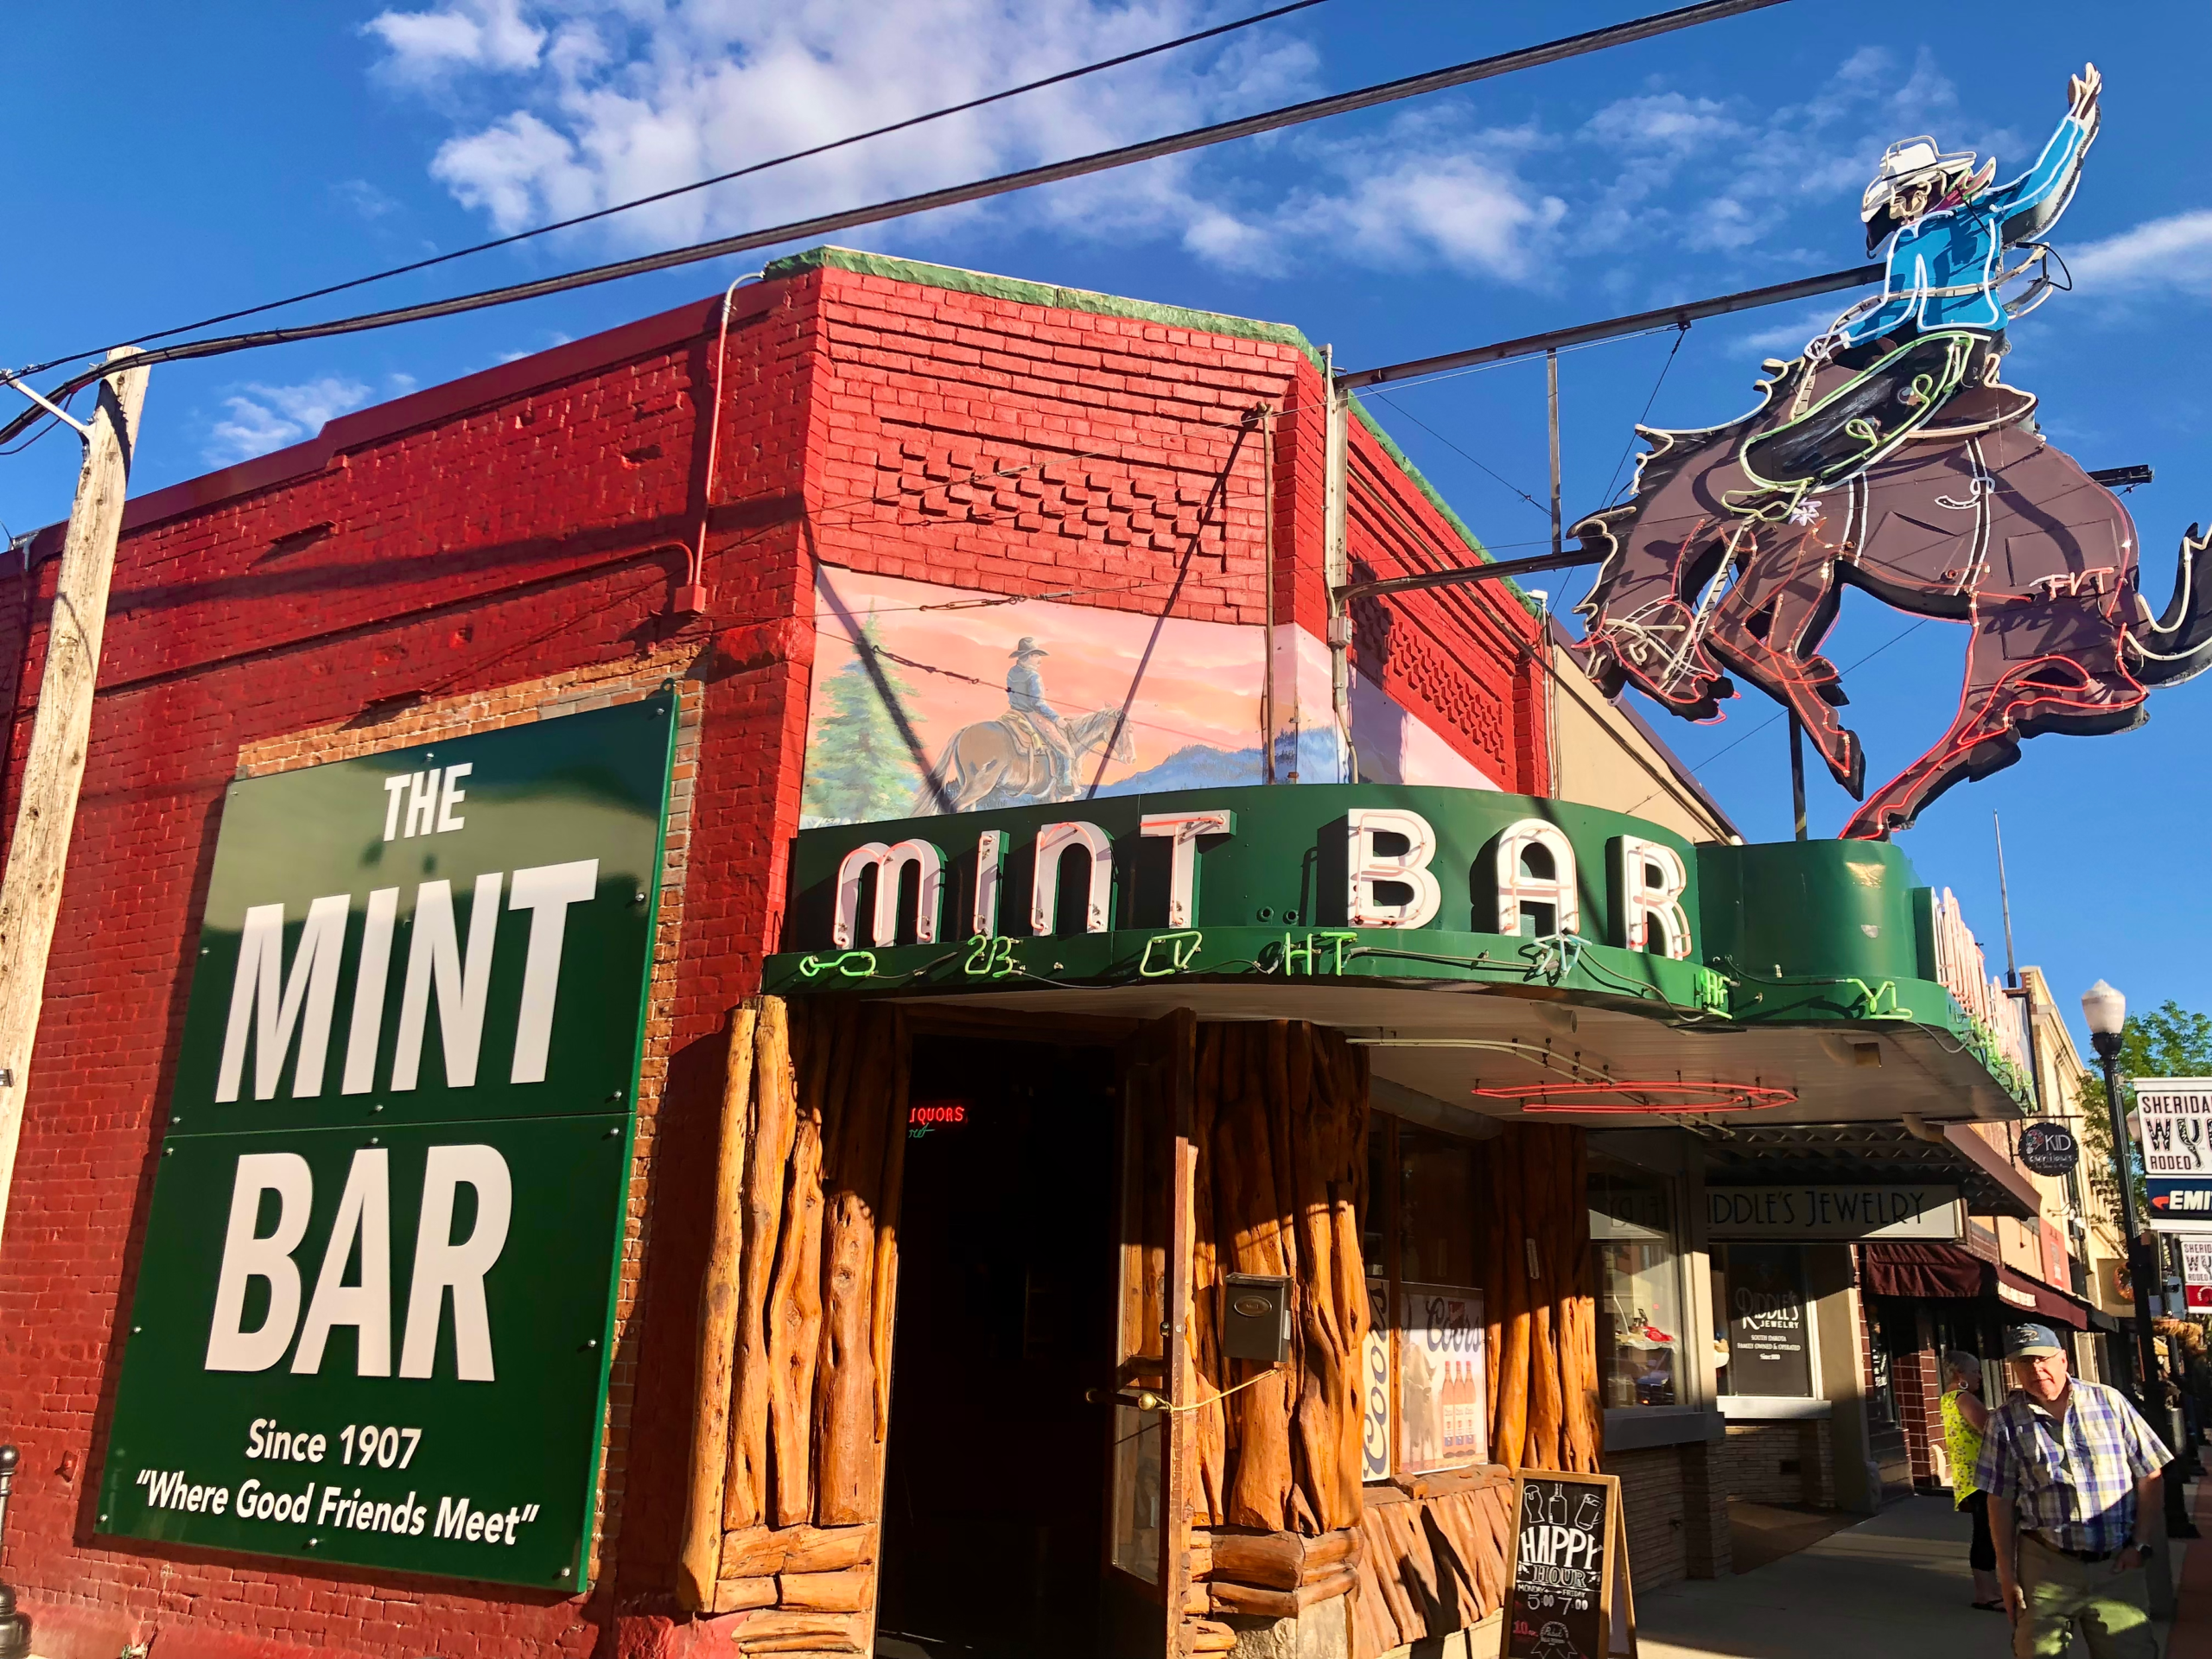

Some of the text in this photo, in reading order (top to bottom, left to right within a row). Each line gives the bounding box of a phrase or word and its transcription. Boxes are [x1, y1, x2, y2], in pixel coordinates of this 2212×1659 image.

[384, 762, 473, 842] THE
[1347, 808, 1693, 961] BAR
[215, 858, 600, 1104] MINT
[908, 1106, 965, 1126] IQUORS
[2142, 1096, 2212, 1115] SHERIDA
[2044, 1134, 2072, 1152] KID
[2150, 1155, 2192, 1171] RODEO
[1706, 1192, 1925, 1227] IDDLE'S JEWELRY
[2169, 1190, 2212, 1211] EMI
[205, 1144, 513, 1382] BAR
[2188, 1273, 2209, 1281] RODEO
[1426, 1297, 1482, 1353] Coors
[1760, 1319, 1800, 1329] JEWELRY
[245, 1418, 423, 1469] Since 1907
[237, 1479, 315, 1523] Good
[317, 1486, 426, 1536] Friends
[1520, 1525, 1604, 1570] HAPPY
[1533, 1564, 1587, 1588] HOUR
[1517, 1583, 1586, 1599] MONDAY FRIDAY
